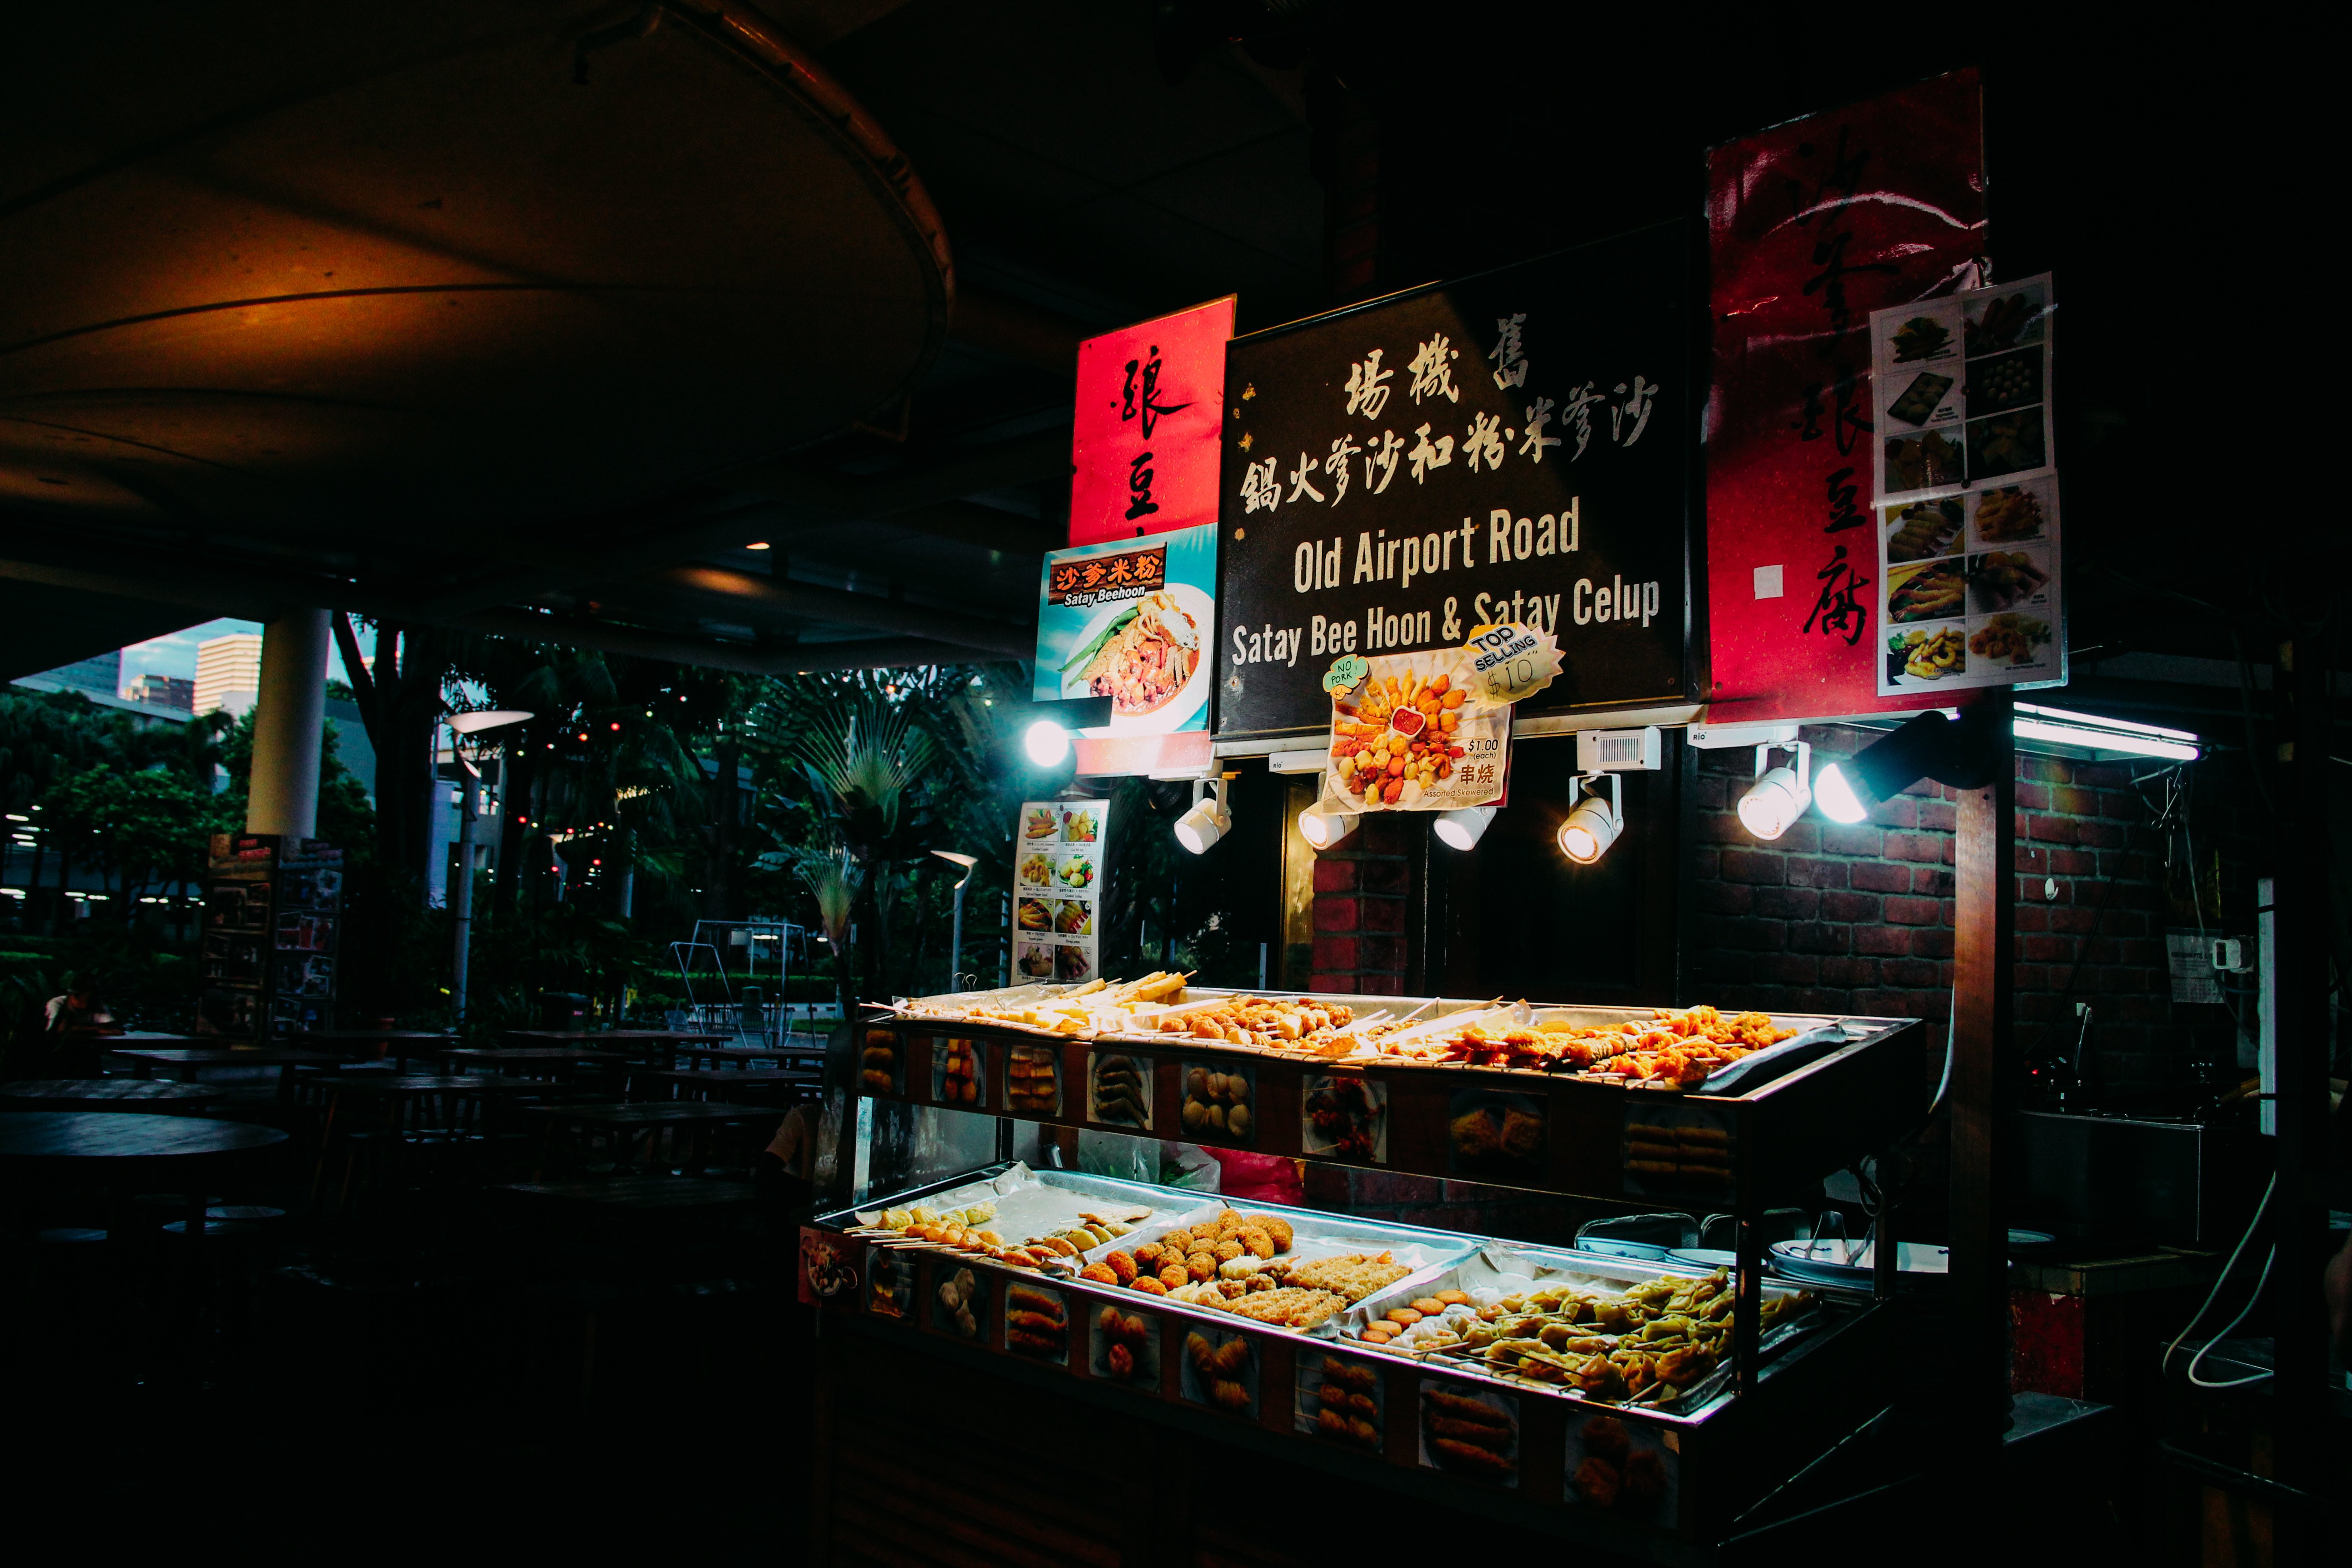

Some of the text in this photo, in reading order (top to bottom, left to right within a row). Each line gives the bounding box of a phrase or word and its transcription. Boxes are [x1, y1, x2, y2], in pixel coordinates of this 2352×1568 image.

[1294, 496, 1579, 593] Old Airport Road
[1057, 554, 1160, 591] 沙爹米粉
[1065, 586, 1145, 606] Satay Beehoon
[1232, 575, 1659, 668] Satay Bee Hoon & Satay Celup
[1470, 627, 1514, 652] TOP
[1475, 635, 1536, 671] SELLING
[1469, 739, 1498, 752] $1.00
[1460, 764, 1495, 785] 串烧
[1423, 788, 1493, 797] Assorted Skewered
